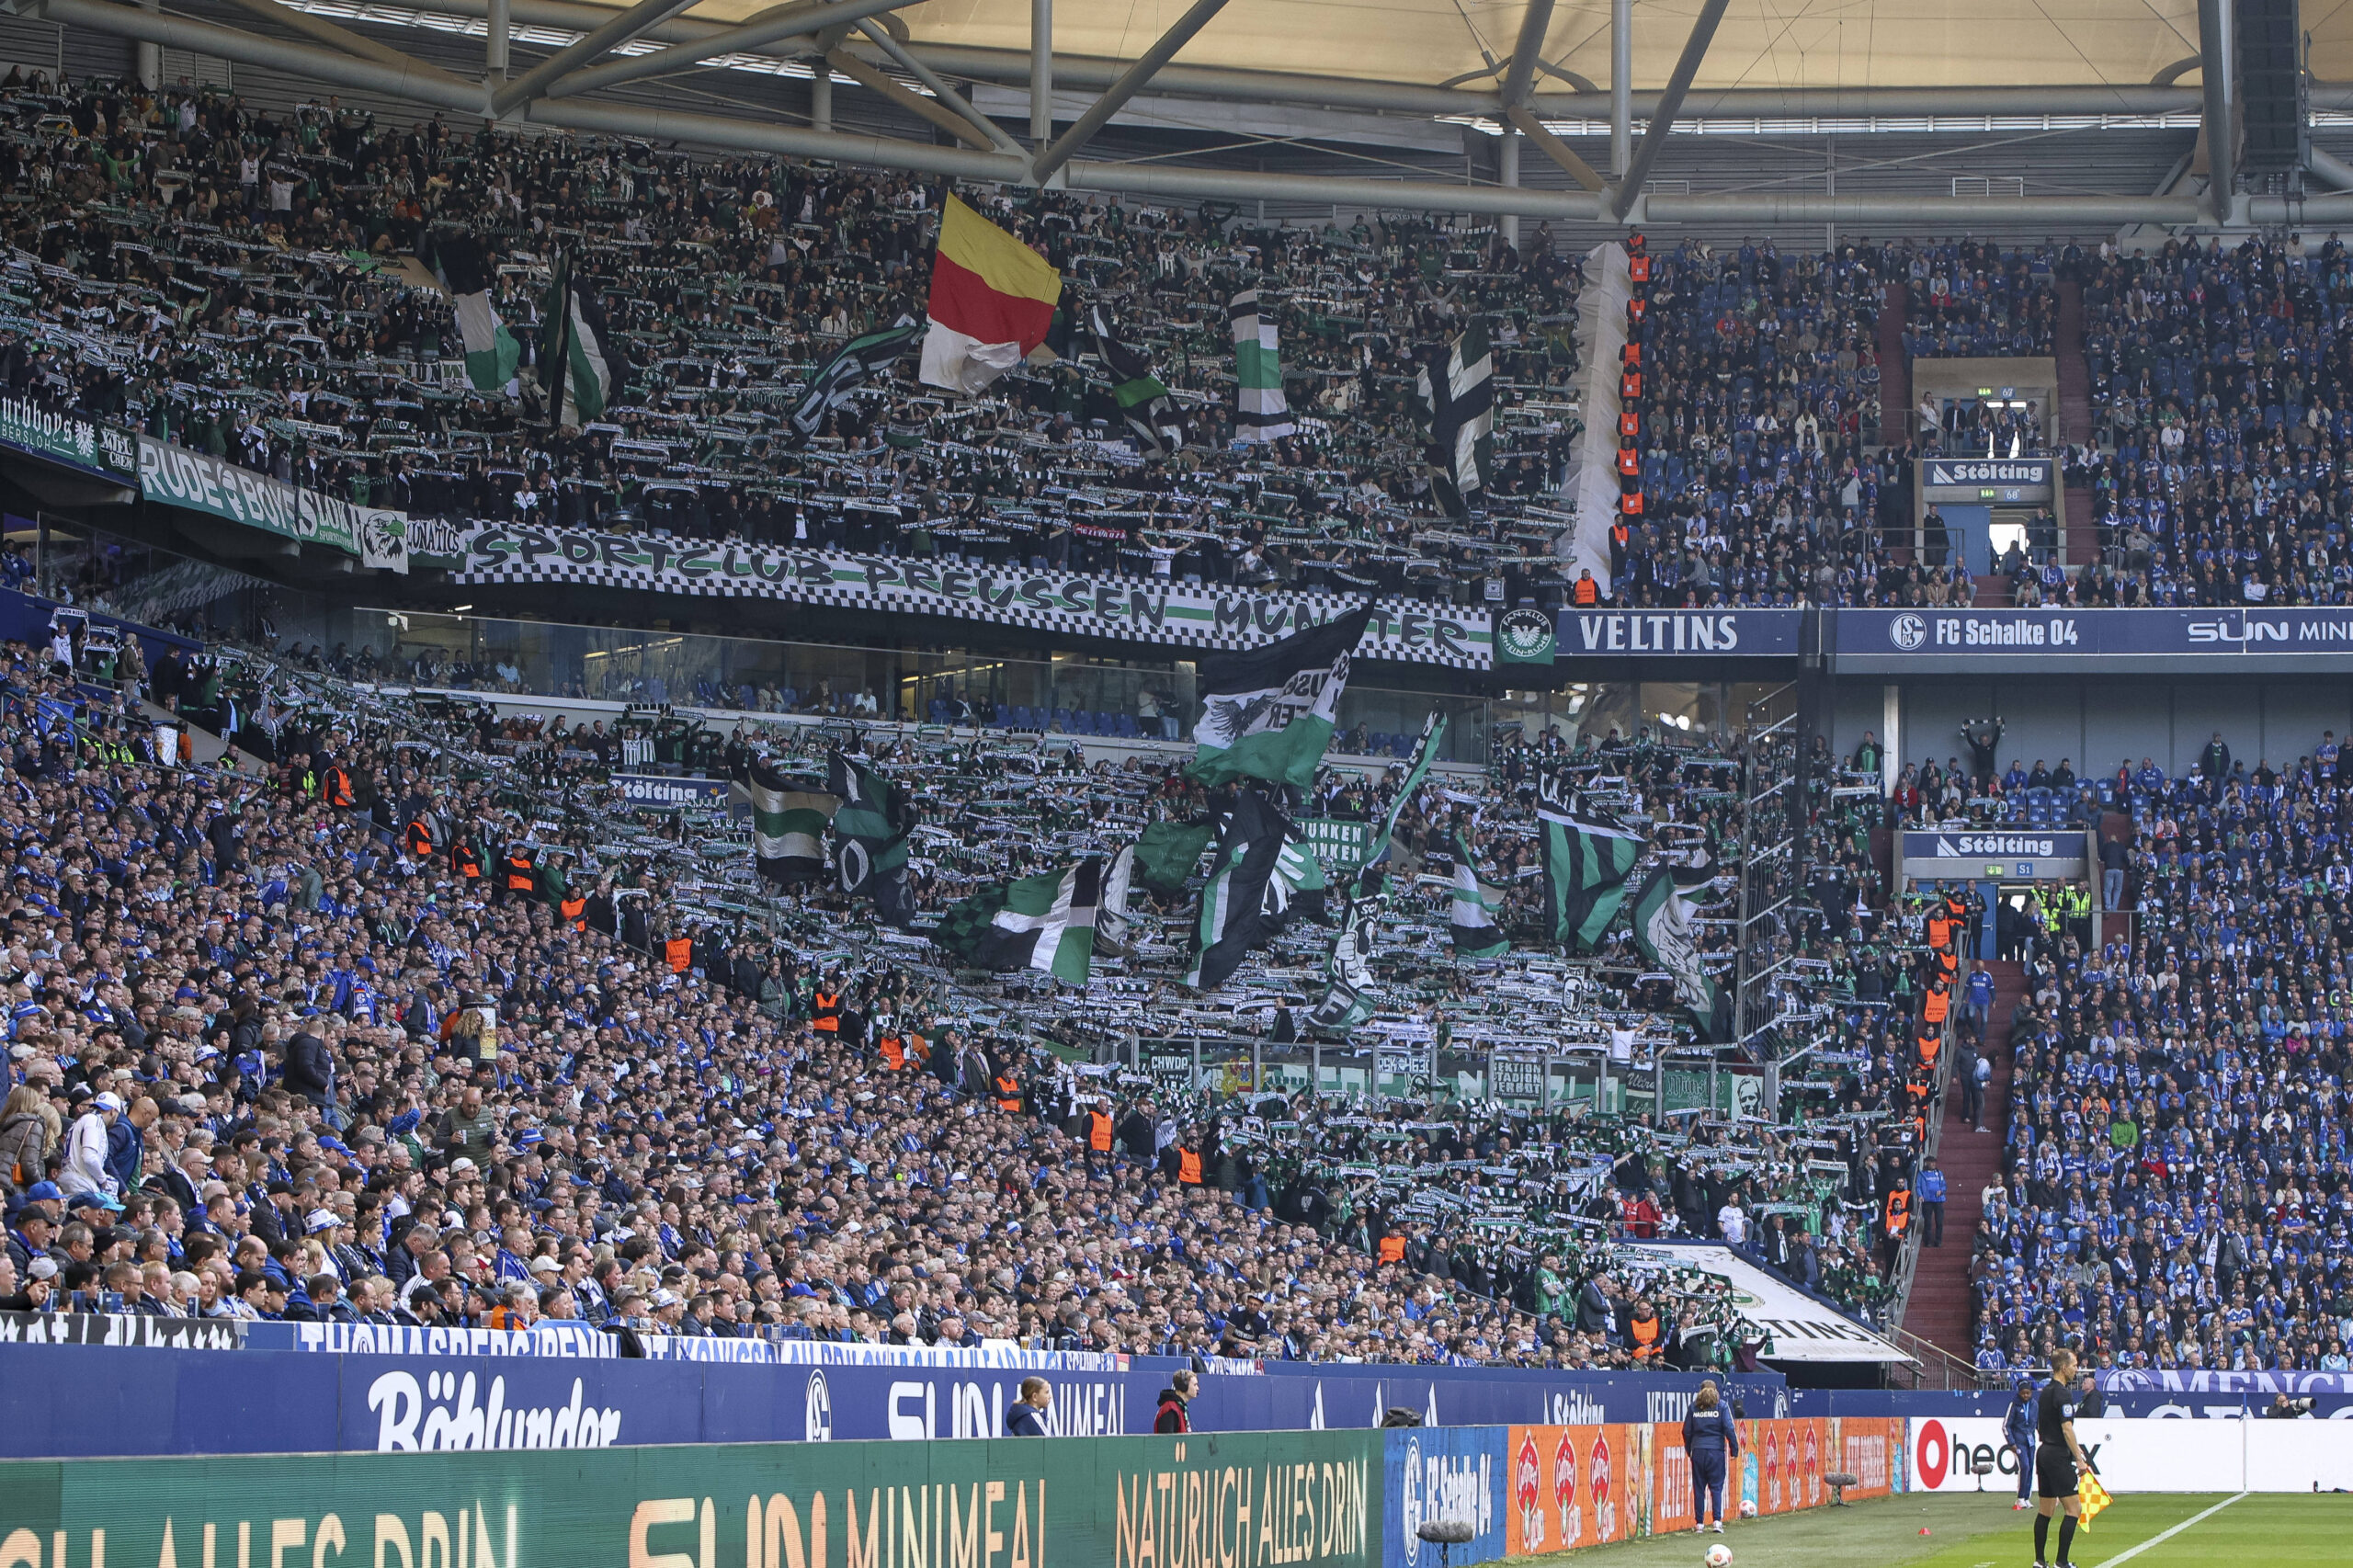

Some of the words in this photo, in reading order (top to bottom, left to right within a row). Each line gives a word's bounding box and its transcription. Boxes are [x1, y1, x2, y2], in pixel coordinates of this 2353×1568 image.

[141, 441, 222, 507] RUDE
[1953, 463, 2043, 482] Stölting
[472, 528, 835, 588] SPORTCLUB
[855, 557, 1166, 629] PREUSSEN
[1503, 610, 1549, 627] FAN-KLUB
[1501, 633, 1550, 655] RHEIN-RUHR
[1580, 615, 1738, 651] VELTINS
[1937, 619, 1959, 647] FC
[1963, 619, 2044, 647] Schalke
[2050, 619, 2078, 647] 04
[1959, 835, 2053, 855] Stölting
[1116, 1441, 1251, 1568] NATÜRLICH
[1259, 1464, 1316, 1566] ALLES
[1321, 1456, 1369, 1557] DRIN
